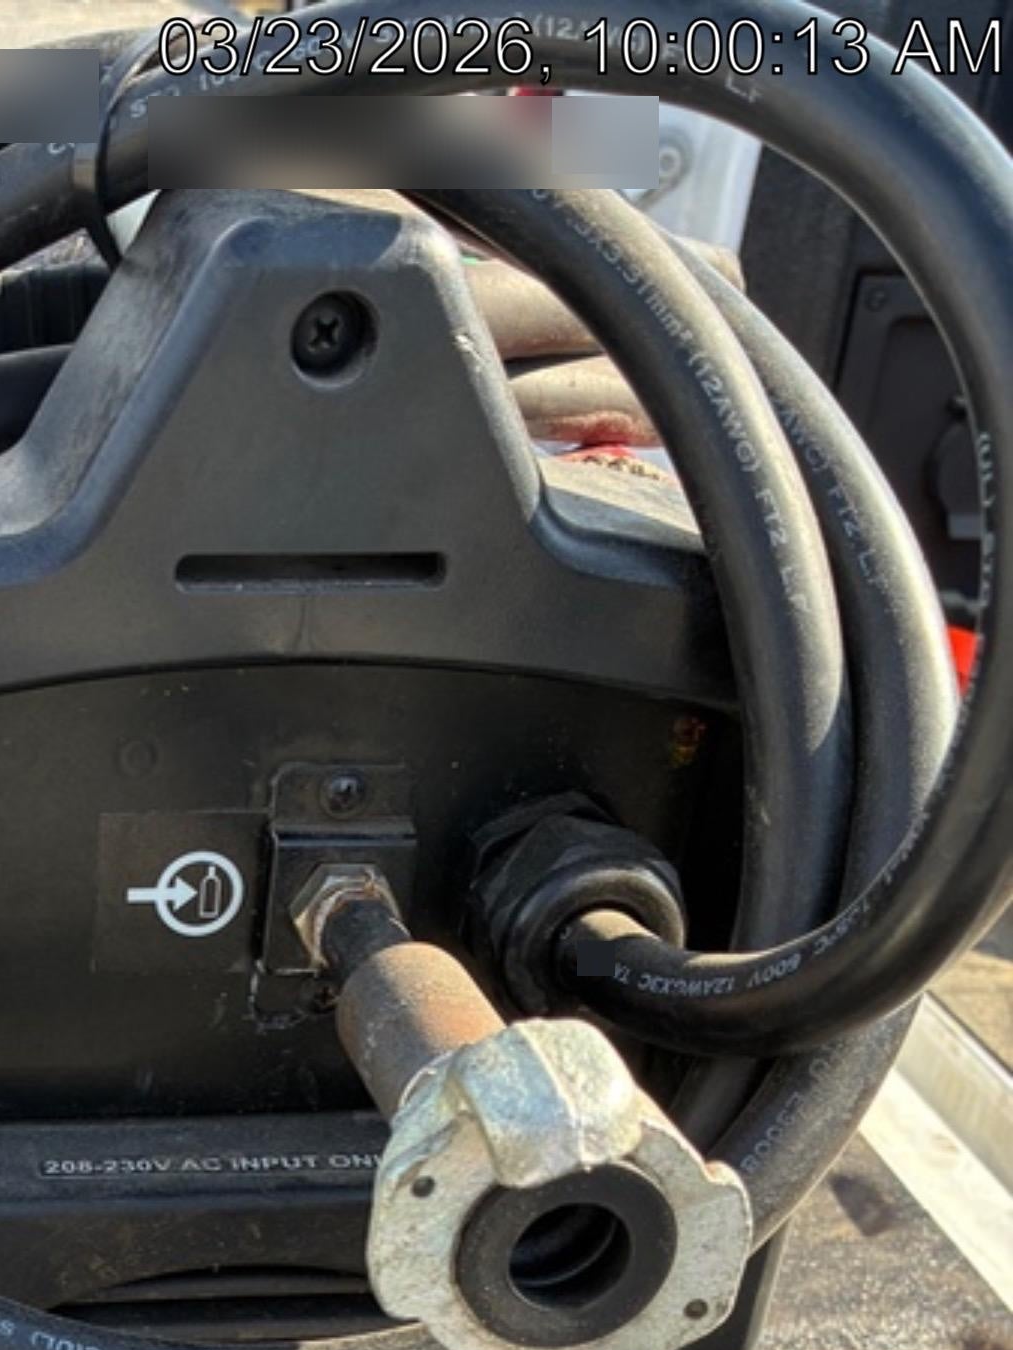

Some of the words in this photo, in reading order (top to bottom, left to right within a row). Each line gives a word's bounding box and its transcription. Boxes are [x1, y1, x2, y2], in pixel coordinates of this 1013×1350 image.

[739, 1091, 806, 1174] E3008
[45, 1160, 170, 1175] 208-230V
[181, 1159, 222, 1172] AC
[232, 1157, 318, 1171] INPUT
